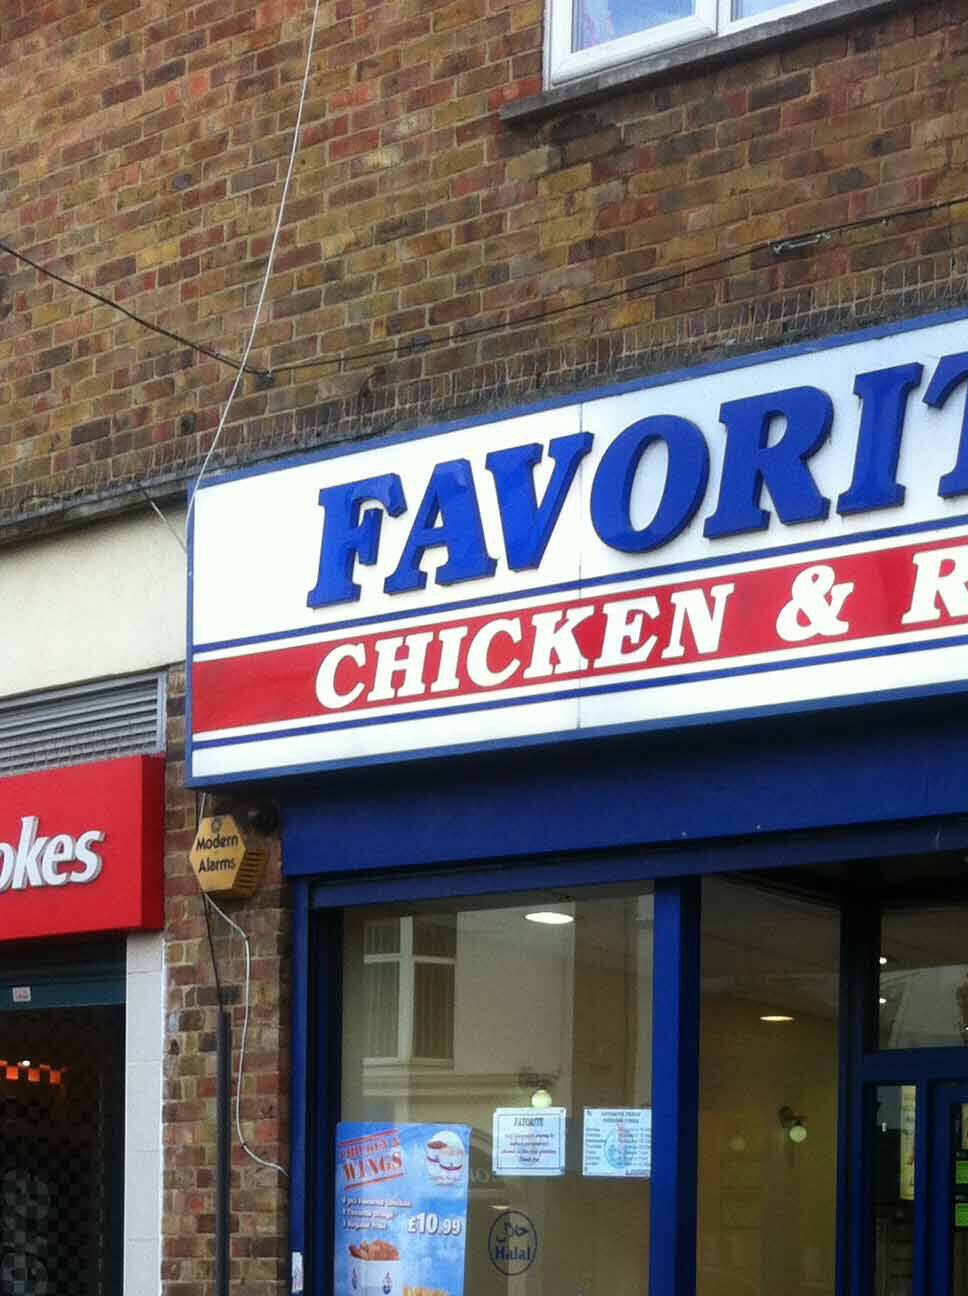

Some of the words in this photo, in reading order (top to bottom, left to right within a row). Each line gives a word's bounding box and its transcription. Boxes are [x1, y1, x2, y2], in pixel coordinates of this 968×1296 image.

[315, 583, 735, 709] CHICKEN
[775, 564, 855, 643] &
[196, 833, 240, 851] Modern
[199, 857, 237, 873] Alarms
[407, 1211, 463, 1237] £10.99
